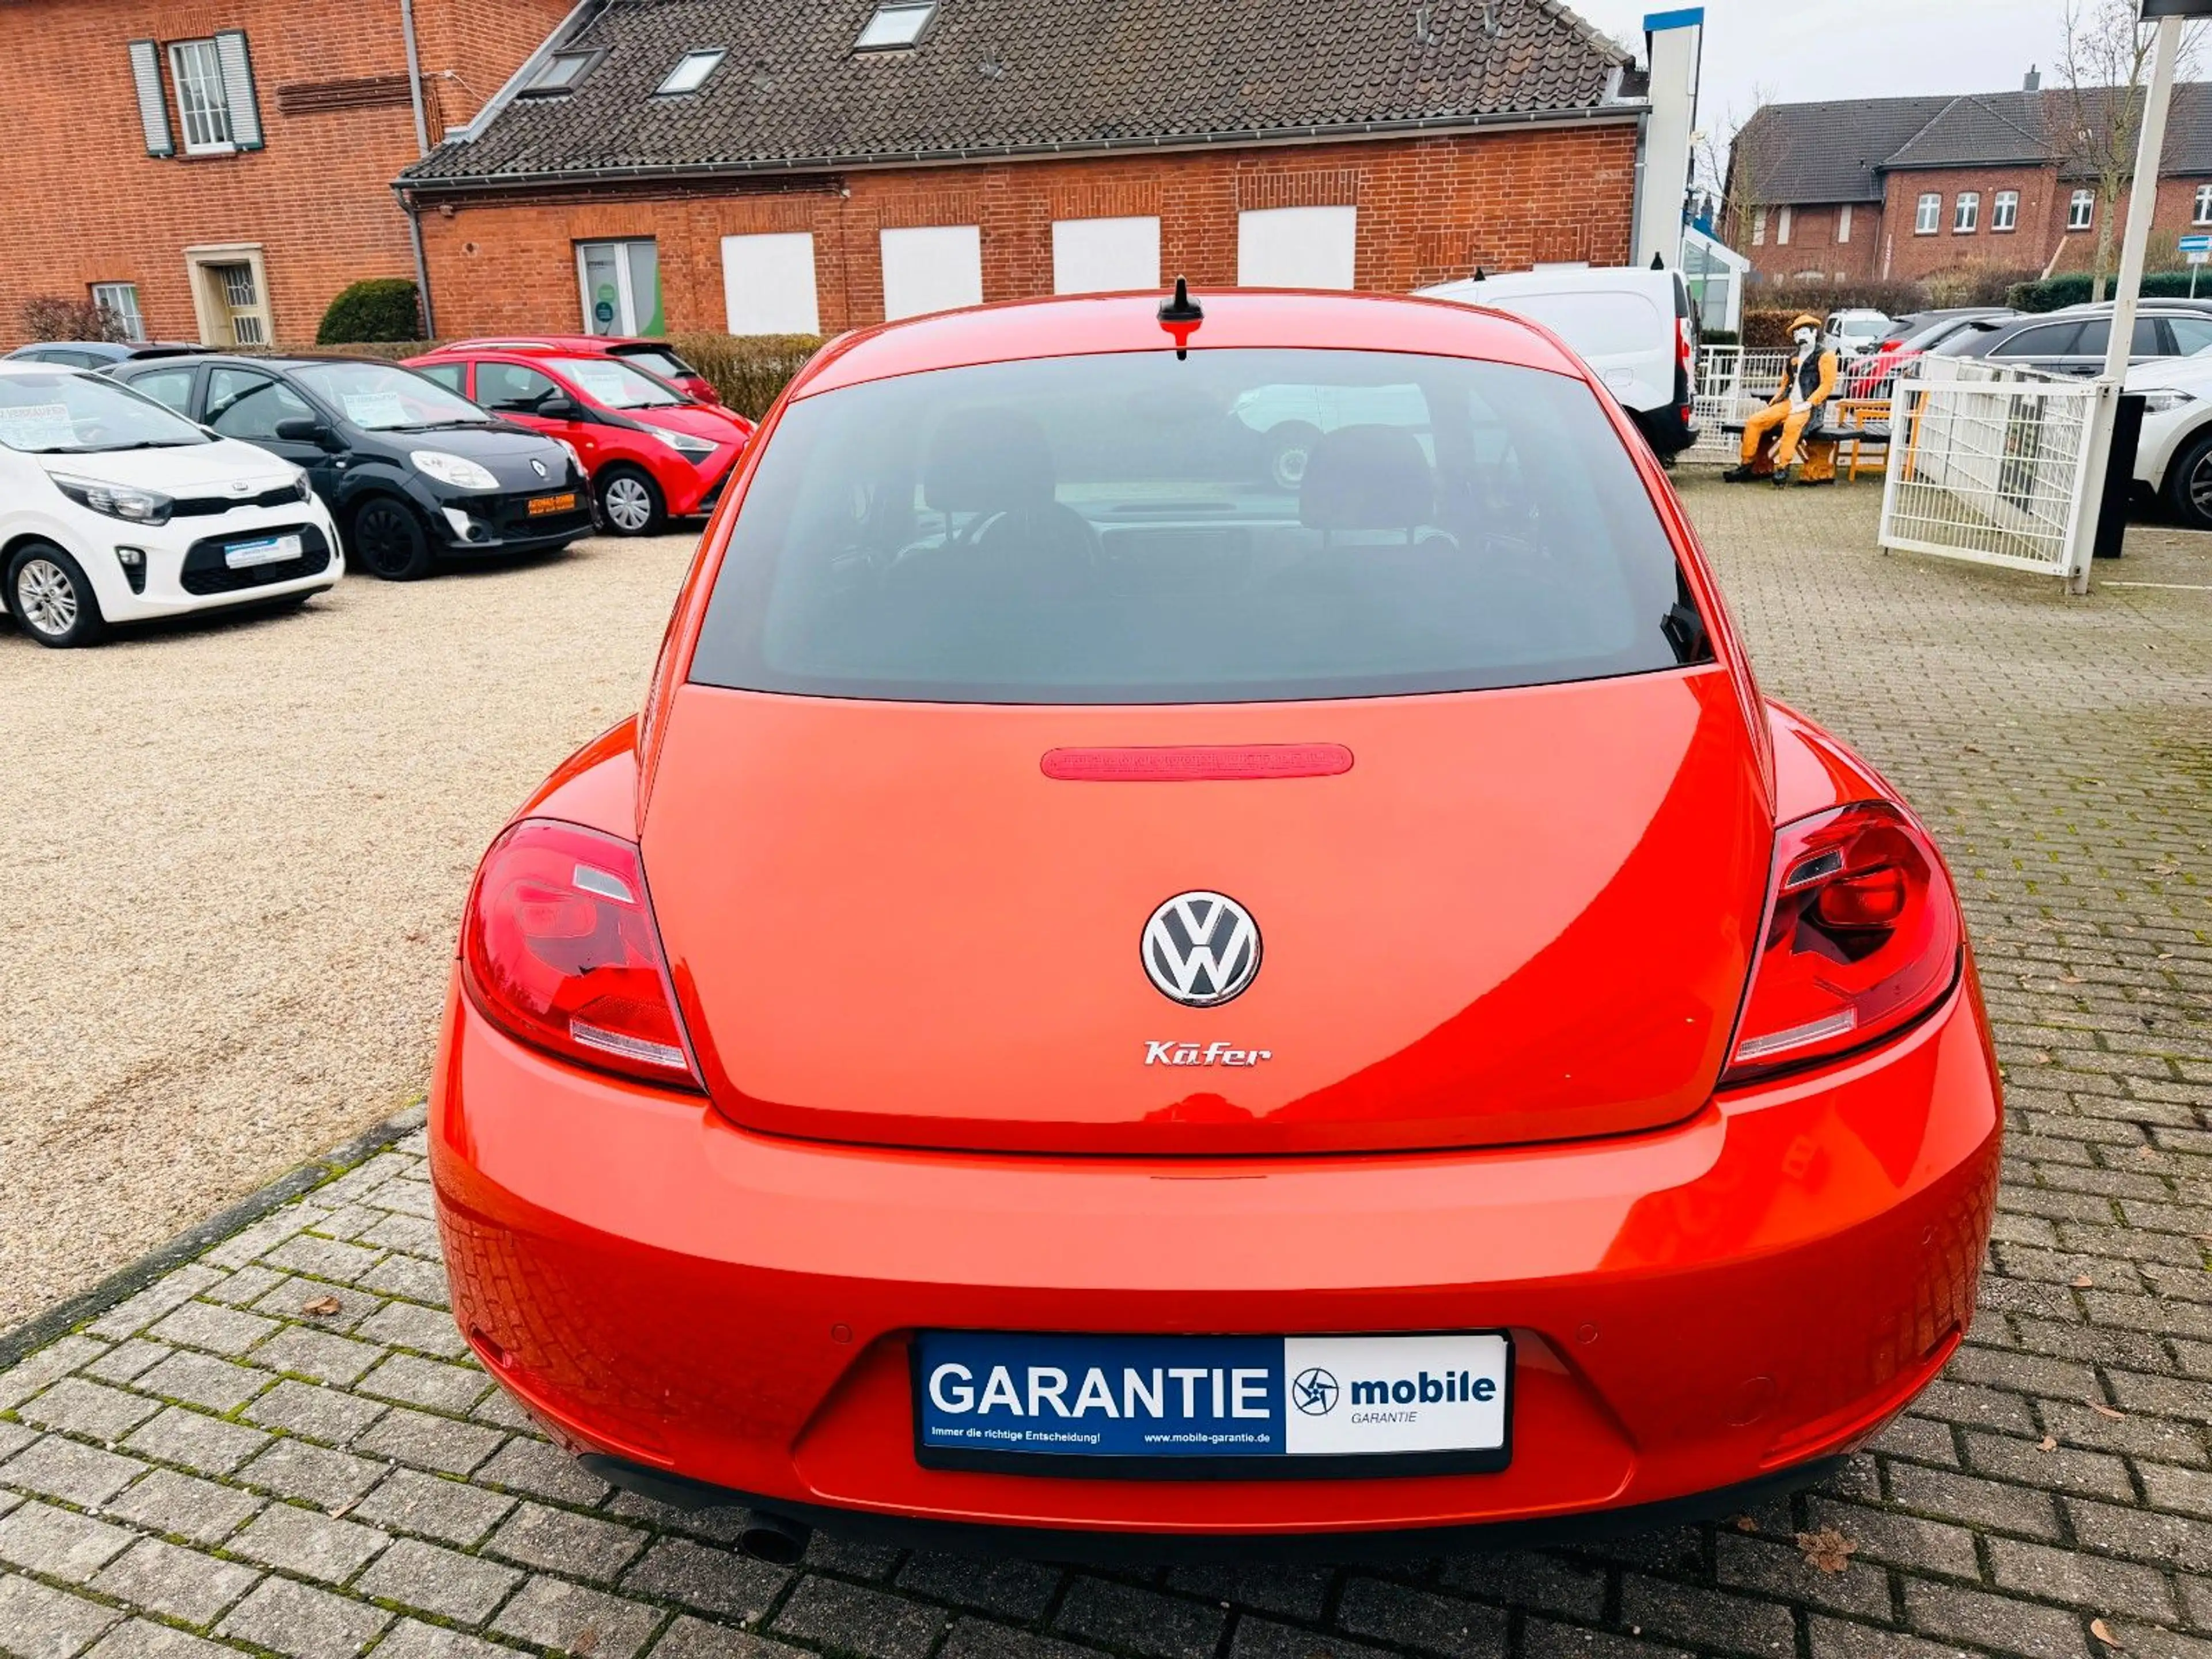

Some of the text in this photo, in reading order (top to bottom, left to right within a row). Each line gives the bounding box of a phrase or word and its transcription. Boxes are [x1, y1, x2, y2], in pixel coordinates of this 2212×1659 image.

[929, 1362, 1270, 1418] GARANTIE
[1351, 1370, 1496, 1405] mobile
[1351, 1411, 1418, 1424] GARANTIE
[931, 1426, 1101, 1444] Immer die richtige Entscheidung!
[1144, 1432, 1271, 1444] www.mobile-garantie.de
